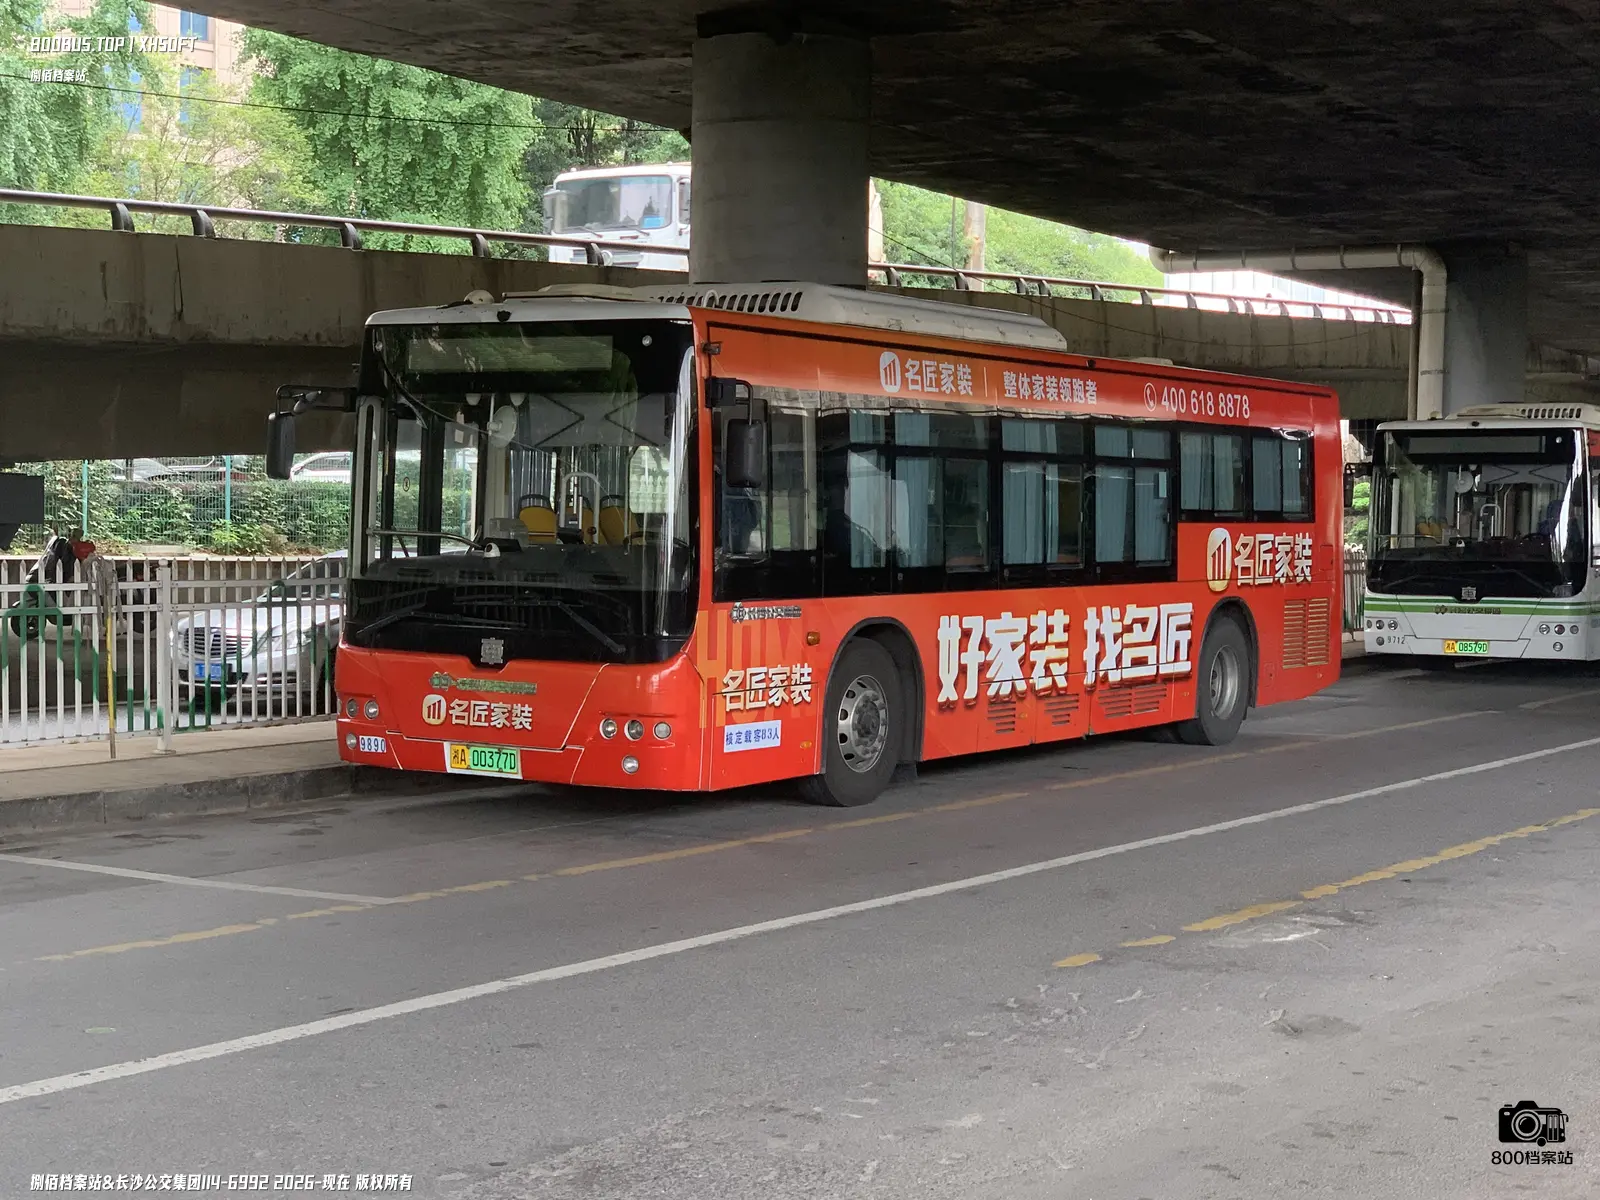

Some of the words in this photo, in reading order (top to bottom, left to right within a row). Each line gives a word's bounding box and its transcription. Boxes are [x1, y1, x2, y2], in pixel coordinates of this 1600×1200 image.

[1003, 370, 1098, 404] 整体家装领跑者
[1161, 386, 1186, 413] 400
[1190, 389, 1214, 416] 618
[1218, 393, 1250, 419] 8878
[937, 608, 1070, 705] 好家装
[1083, 602, 1194, 688] 找名匠
[1387, 635, 1406, 645] 9712
[360, 736, 386, 752] 9890
